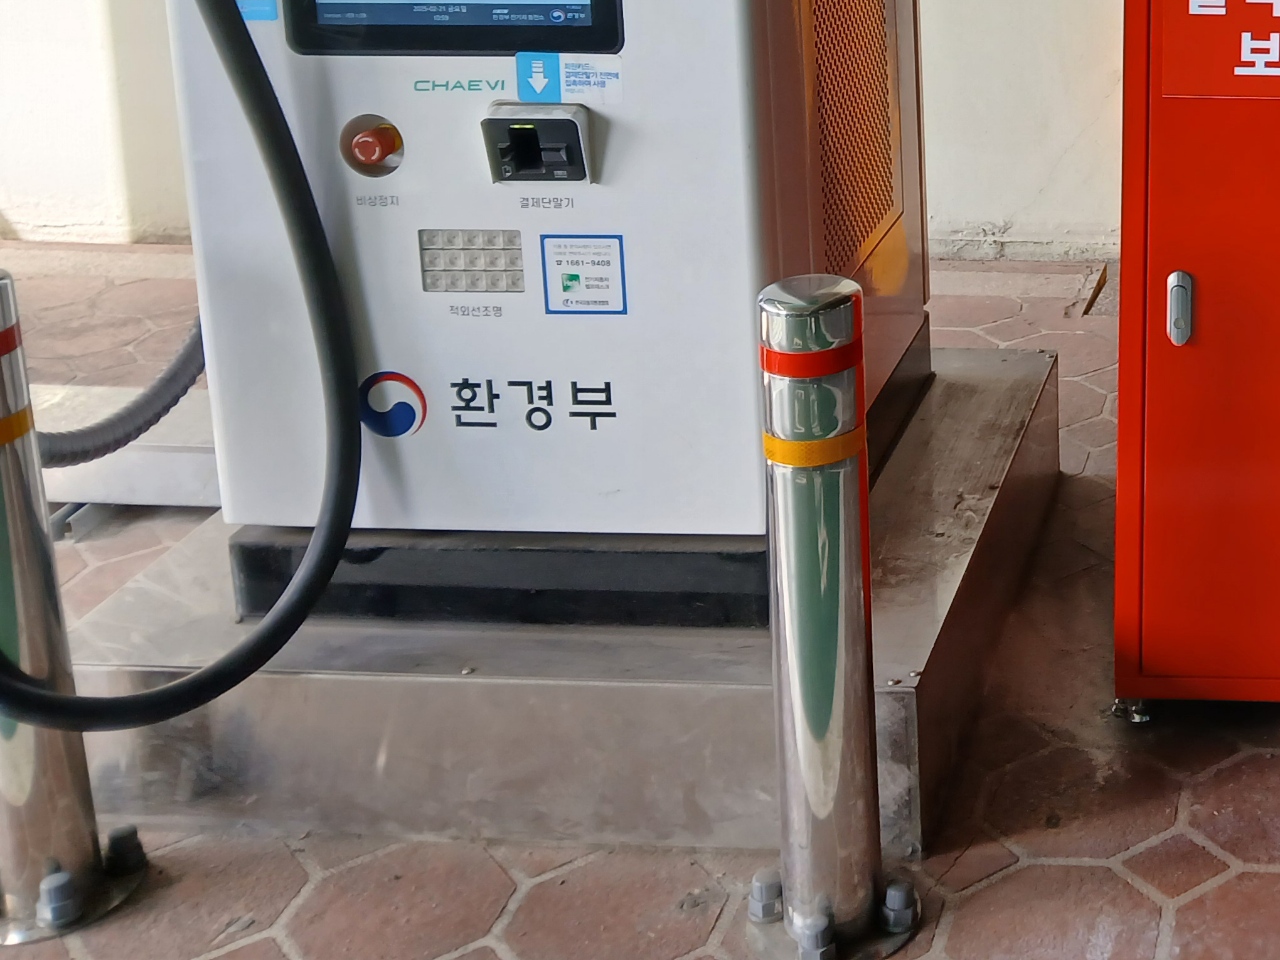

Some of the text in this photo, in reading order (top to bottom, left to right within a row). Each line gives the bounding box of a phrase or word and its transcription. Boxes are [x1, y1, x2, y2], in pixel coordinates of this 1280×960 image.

[413, 79, 506, 92] CHAEVI
[356, 195, 400, 207] 비상정지
[519, 196, 575, 209] 결제단말기
[565, 259, 612, 267] 1661-9408
[448, 305, 503, 317] 적외선조명
[450, 378, 617, 431] 환경부
